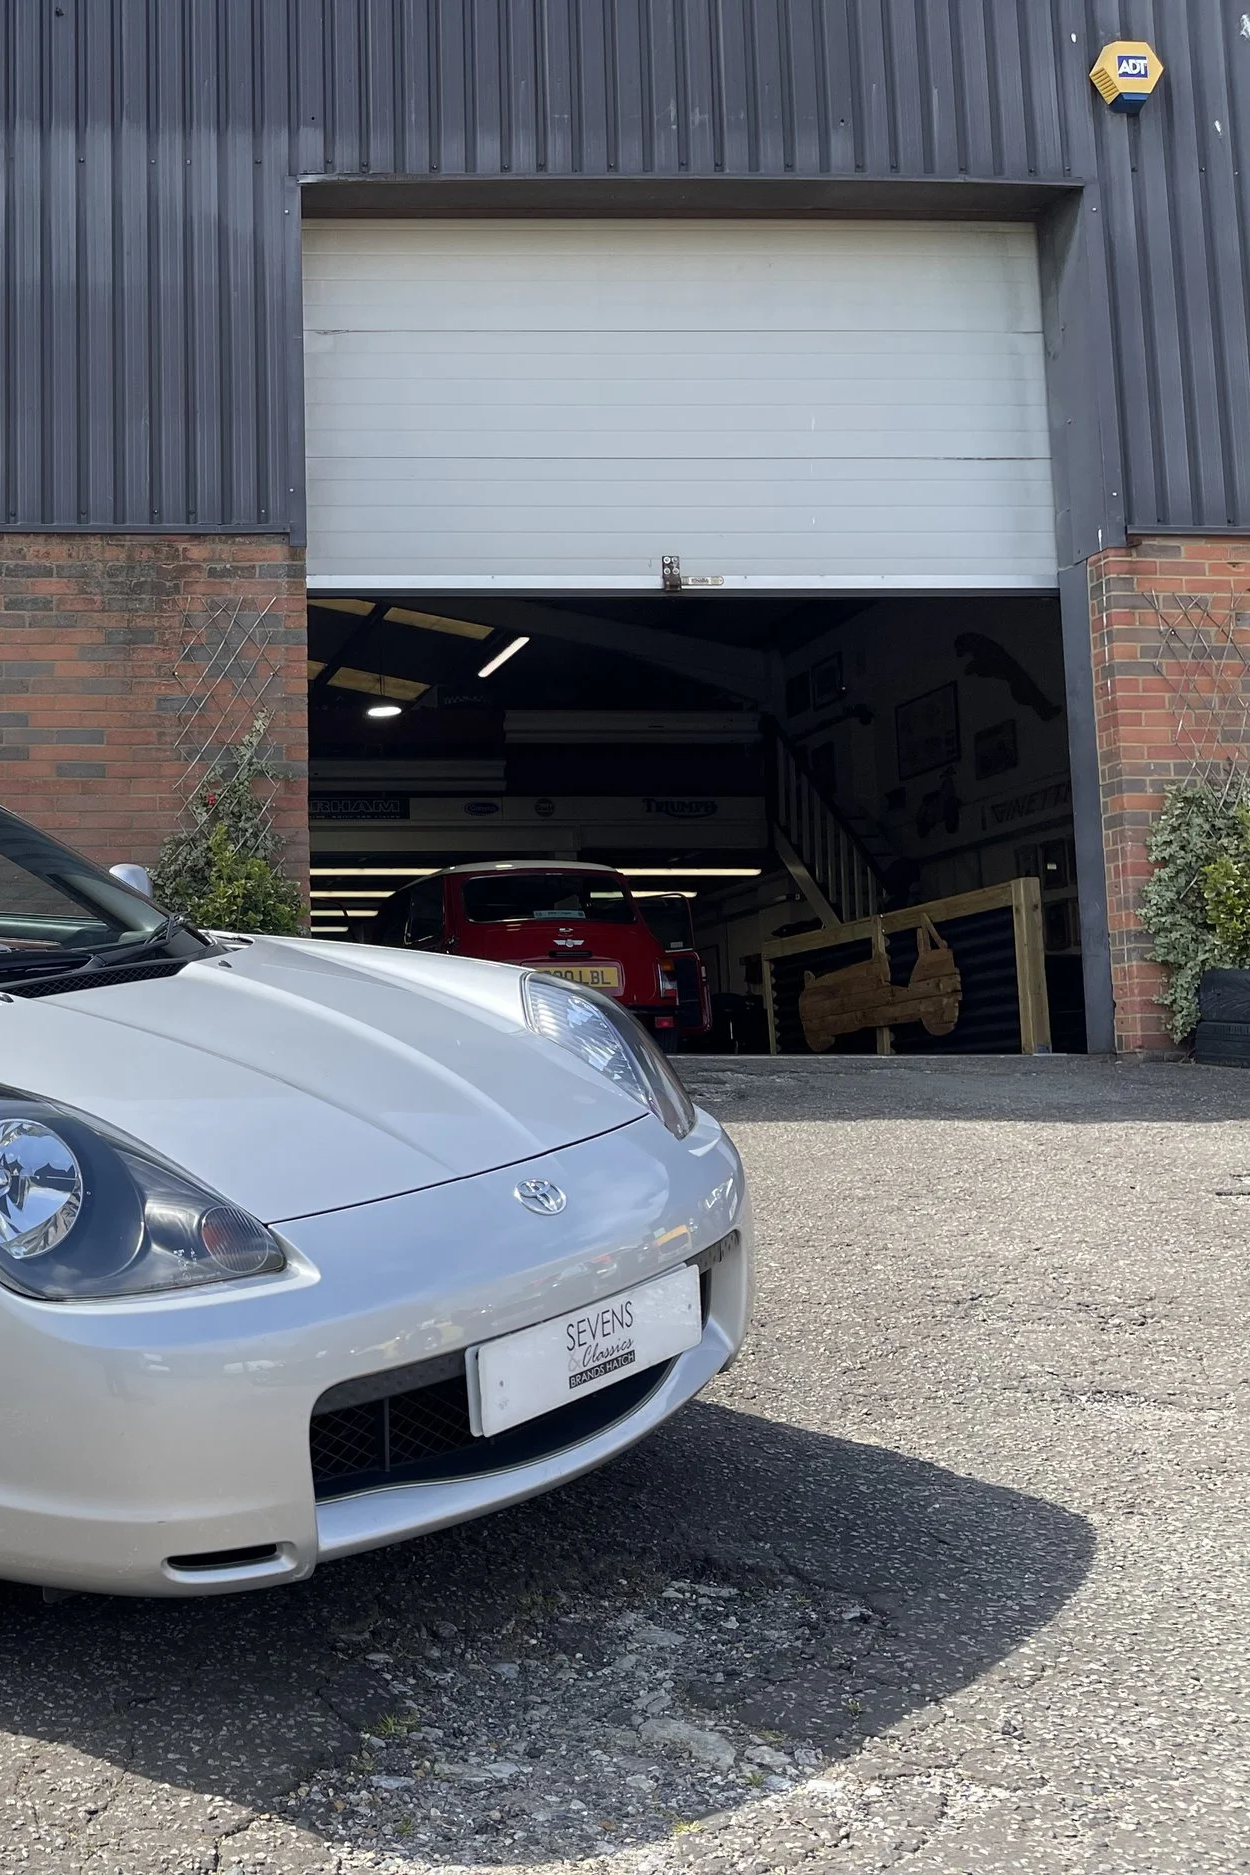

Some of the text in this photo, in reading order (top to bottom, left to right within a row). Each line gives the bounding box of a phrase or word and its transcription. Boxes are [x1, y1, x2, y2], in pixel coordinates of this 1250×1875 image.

[1118, 59, 1148, 75] ADT
[566, 1301, 633, 1351] SEVENS
[582, 1338, 634, 1367] Classics
[570, 1353, 633, 1389] BRANDS HATCH
